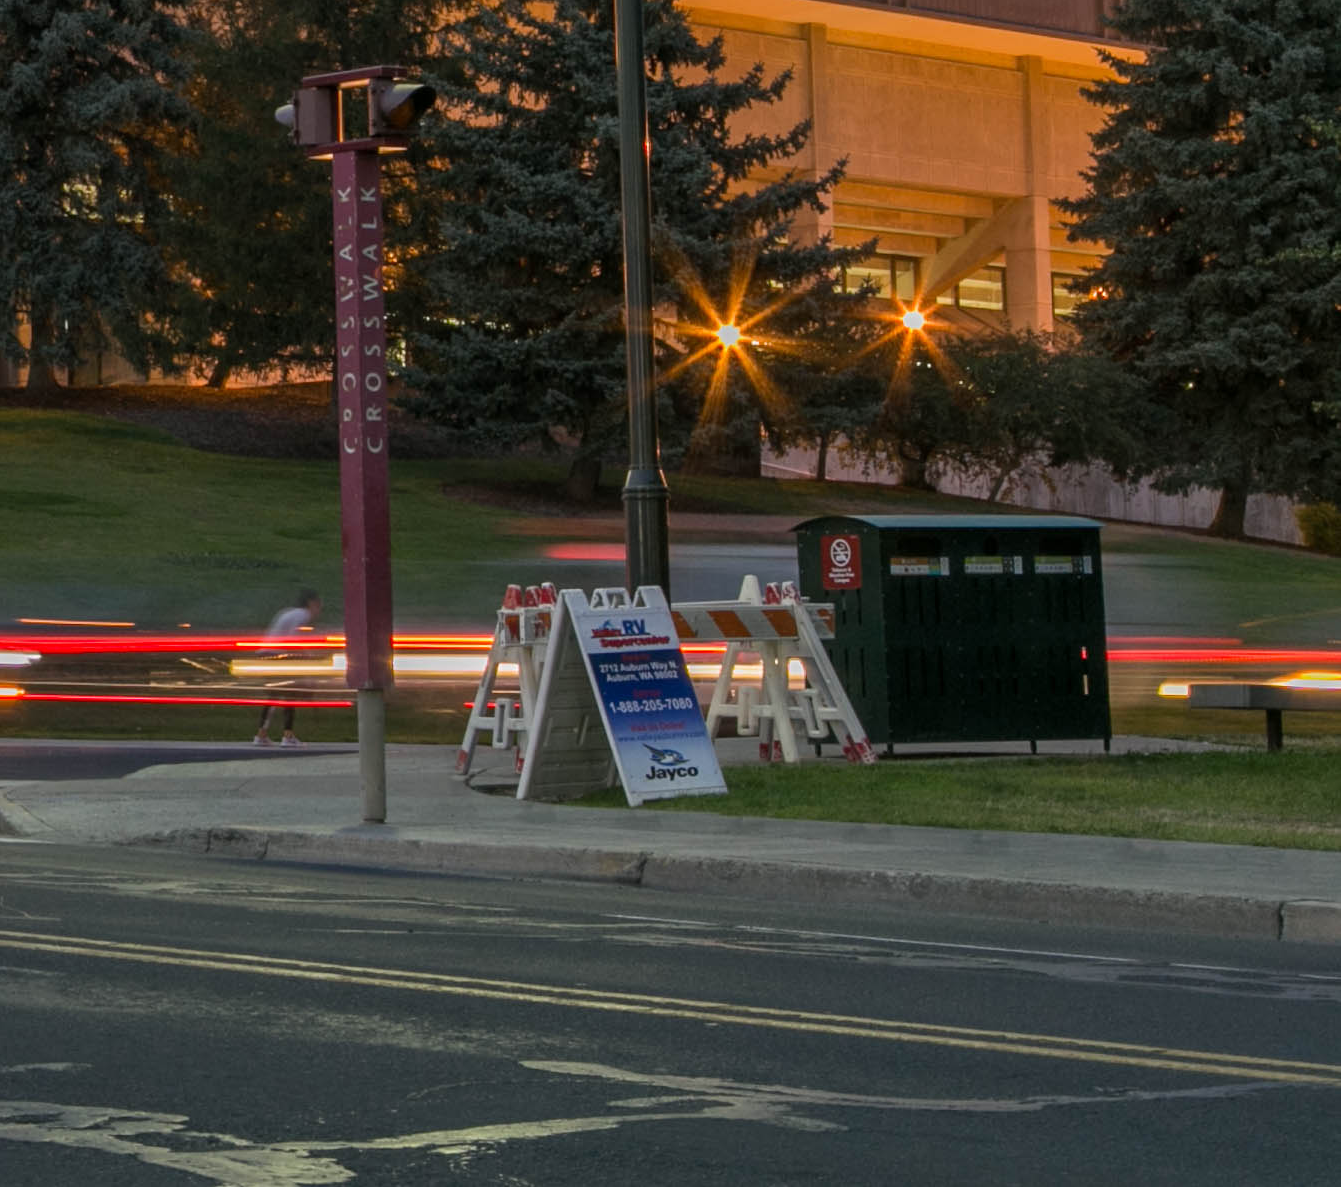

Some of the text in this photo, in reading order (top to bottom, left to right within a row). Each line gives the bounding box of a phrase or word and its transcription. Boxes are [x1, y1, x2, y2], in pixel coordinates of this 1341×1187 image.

[360, 186, 384, 454] CROSSWALK
[622, 619, 645, 635] RV
[620, 661, 650, 672] Auburn
[649, 661, 668, 671] Way
[639, 672, 654, 681] WA
[609, 697, 694, 714] 1-888-205-7080
[646, 765, 699, 781] Jayco
